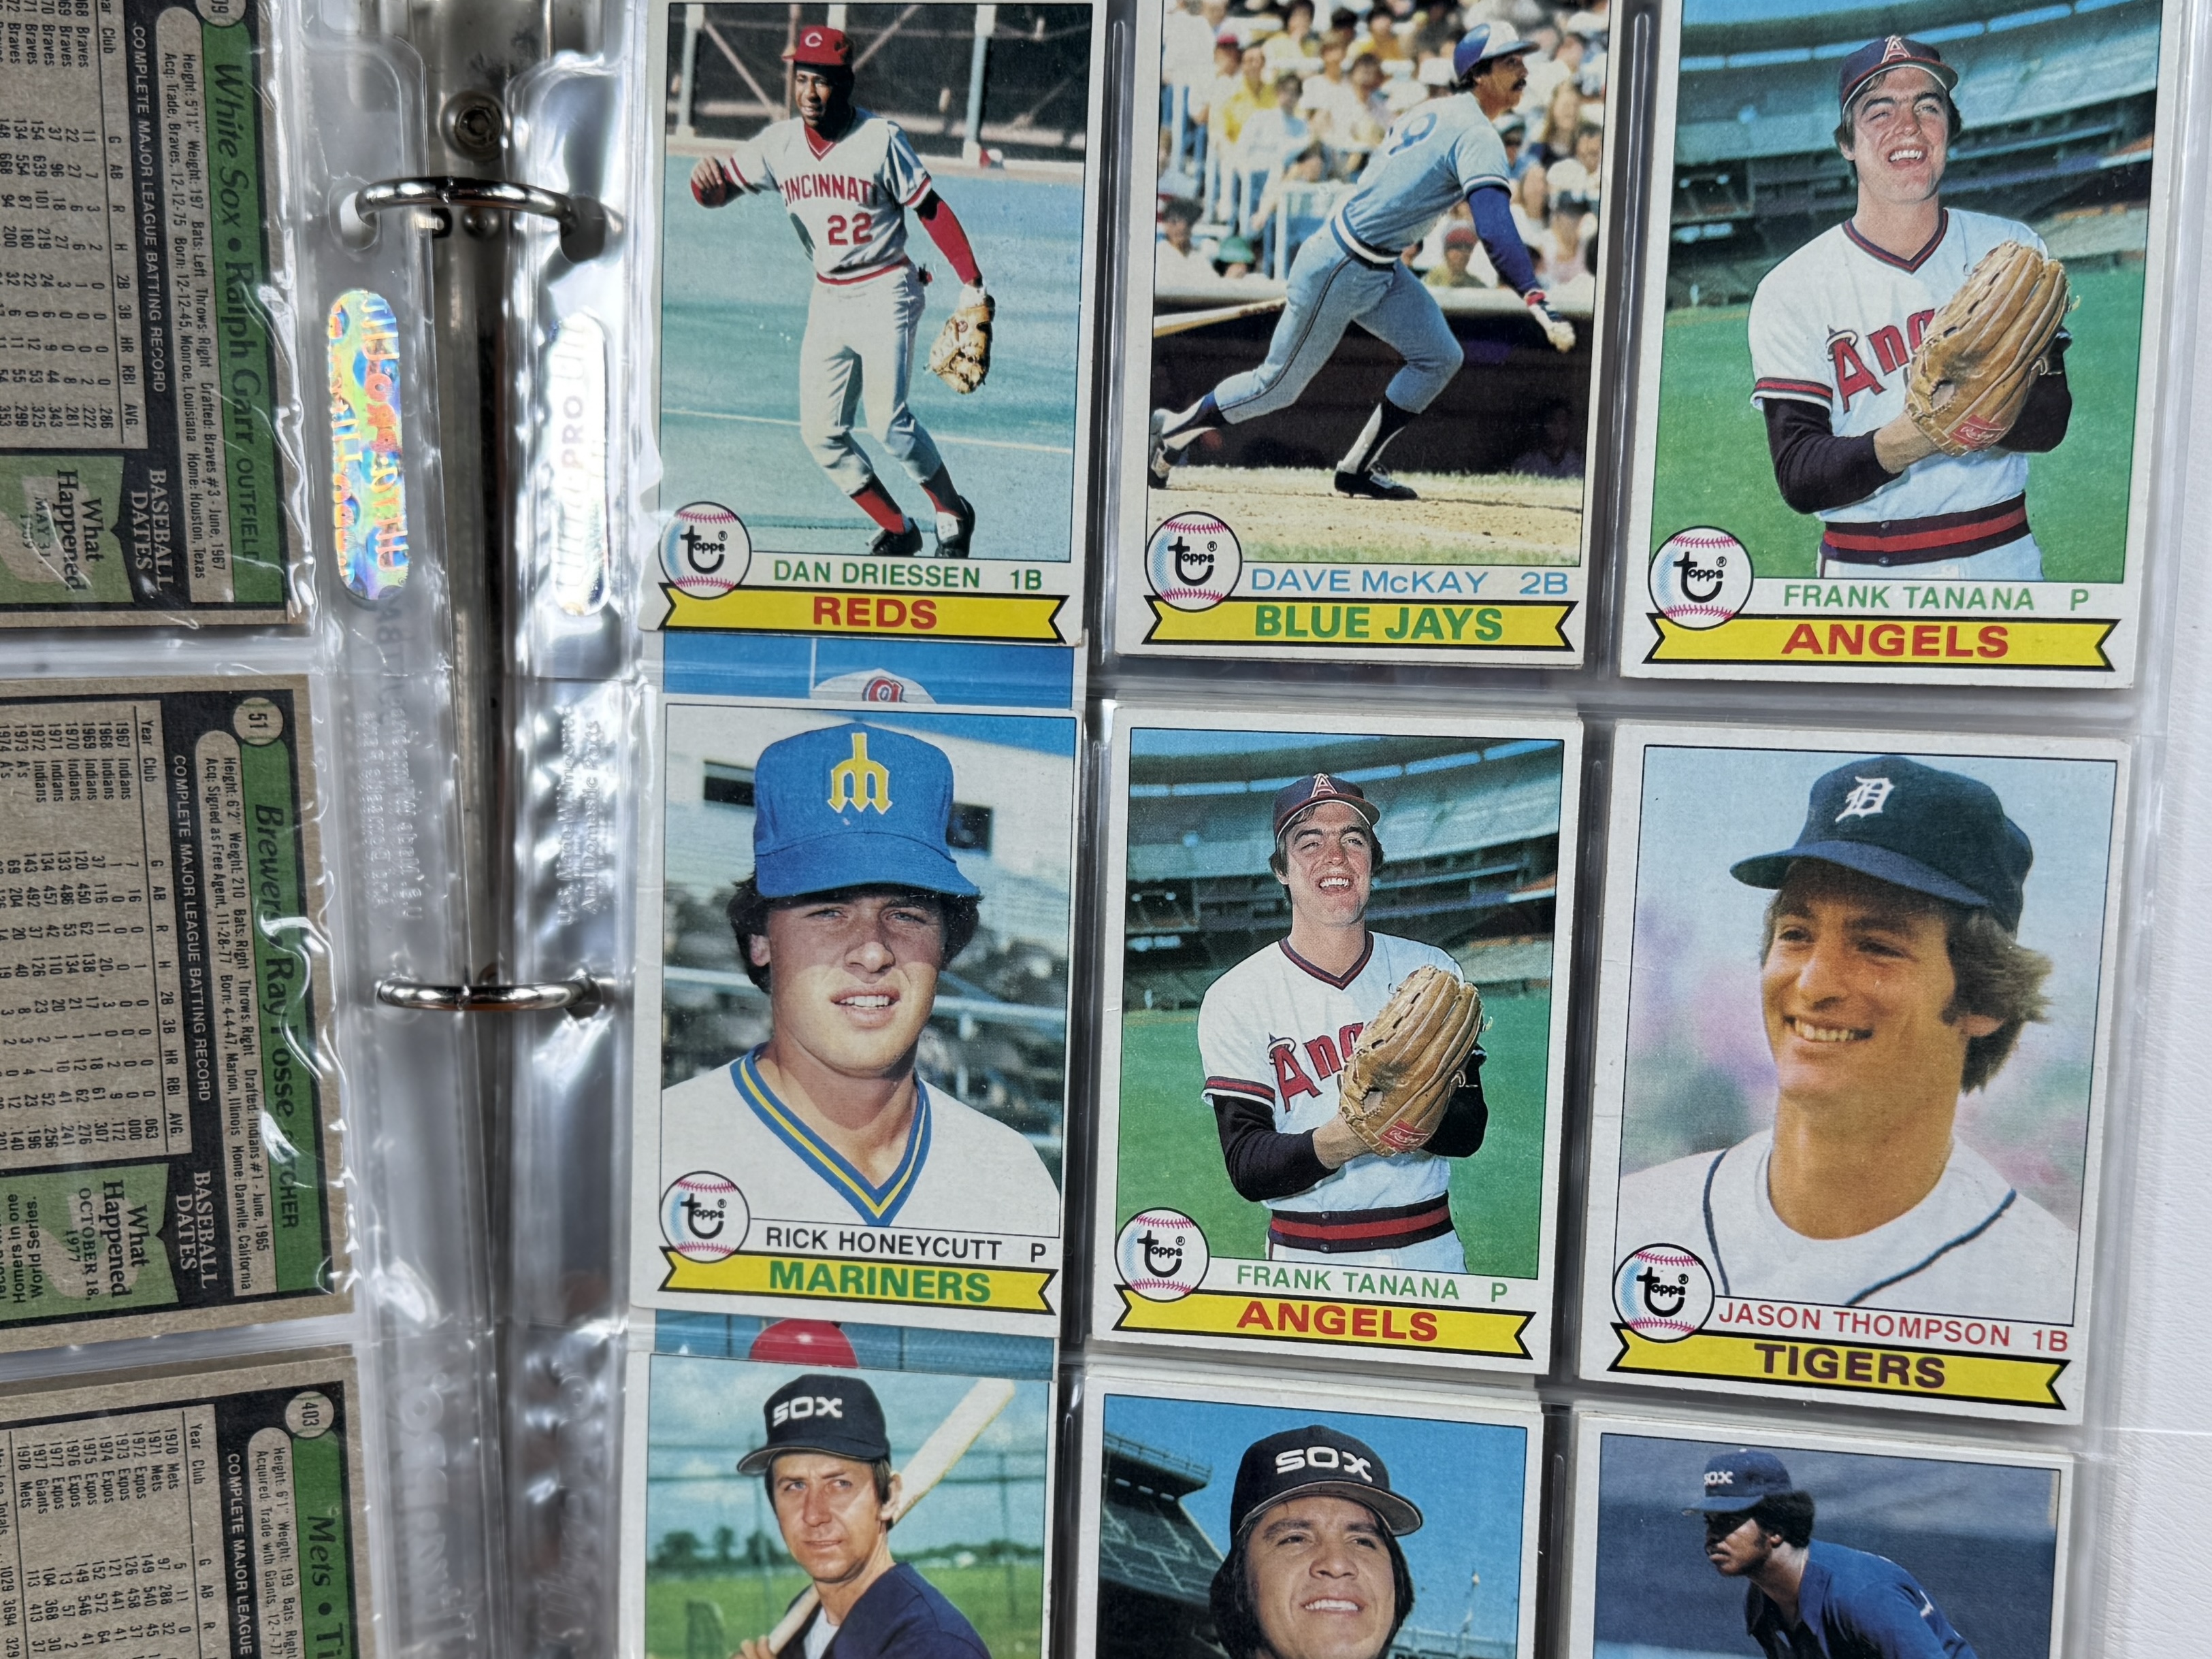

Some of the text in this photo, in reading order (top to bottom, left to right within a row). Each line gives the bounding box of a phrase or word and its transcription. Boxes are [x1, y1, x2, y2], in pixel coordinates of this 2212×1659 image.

[180, 54, 196, 95] Height:
[185, 141, 201, 183] Weight:
[133, 27, 165, 392] COMPLETE MAJOR LEAGUE BATTING RECORD
[189, 189, 204, 209] 197
[191, 220, 204, 250] Bats:
[827, 212, 873, 246] 22
[193, 254, 207, 277] Left
[163, 52, 206, 578] Acq: Trade, Braves, 12-12-75 Born: 12-12-45, Monroe, Louisiana Home: Houston, Texas
[195, 288, 208, 332] Throws:
[214, 64, 261, 564] White Sox Ralph Garr OUTFIELD
[195, 338, 212, 367] Right
[200, 382, 215, 429] Drafted:
[204, 433, 216, 473] Braves
[52, 469, 87, 591] Happened
[81, 497, 104, 561] What
[131, 491, 152, 569] DATES
[149, 469, 173, 591] BASEBALL
[208, 508, 221, 538] June,
[211, 543, 225, 570] 1967
[775, 560, 1043, 591] DAN DRIESSEN 1B
[1252, 568, 1569, 595] DAVE McKAY 2B
[1783, 585, 2089, 611] FRANK TANANA P
[813, 596, 938, 630] REDS
[1256, 604, 1503, 642] BLUE JAYS
[1780, 623, 2008, 658] ANGELS
[248, 713, 268, 728] 51
[222, 757, 238, 797] Height:
[227, 832, 243, 874] Weight:
[255, 806, 289, 919] Brewers
[231, 878, 246, 898] 210
[174, 755, 210, 1100] COMPLETE MAJOR LEAGUE BATTING RECORD
[233, 909, 246, 936] Bats:
[233, 940, 249, 969] Right
[238, 980, 251, 1021] Throws:
[265, 957, 293, 1015] Ray
[204, 758, 251, 1290] Acq: Signed as Free Agent, 11-28-77 Born: 4-4-47, Marion, Illinois Home: Danville, California
[239, 1026, 255, 1055] Right
[244, 1069, 259, 1113] Drafted:
[269, 1025, 297, 1117] Fosse
[247, 1118, 259, 1159] Indians
[253, 1193, 265, 1221] June,
[7, 1194, 26, 1304] Homers in one
[25, 1196, 43, 1298] World Series.
[63, 1230, 80, 1262] 1977
[78, 1187, 99, 1301] OCTOBER 18,
[98, 1179, 133, 1298] Happened
[127, 1204, 150, 1267] What
[176, 1194, 197, 1269] DATES
[193, 1171, 217, 1289] BASEBALL
[255, 1225, 269, 1251] 1965
[766, 1227, 1047, 1263] RICK HONEYCUTT P
[769, 1261, 992, 1303] MARINERS
[1237, 1264, 1508, 1302] FRANK TANANA P
[1235, 1300, 1439, 1343] ANGELS
[1718, 1302, 2068, 1352] JASON THOMPSON 1B
[1753, 1343, 1945, 1390] TIGERS
[302, 1402, 319, 1426] 403
[772, 1396, 843, 1427] SOX
[271, 1447, 286, 1485] Height:
[1275, 1446, 1373, 1483] SOX
[17, 1446, 46, 1652] 1978 Mets 113 413 37
[227, 1453, 252, 1654] COMPLETE MAJOR LEAGUE
[255, 1451, 283, 1655] Acquired: Trade with Giants, 12-7-77
[276, 1521, 291, 1562] Weight:
[307, 1516, 336, 1586] Mets
[281, 1568, 294, 1587] 193
[282, 1597, 295, 1624] Bats:
